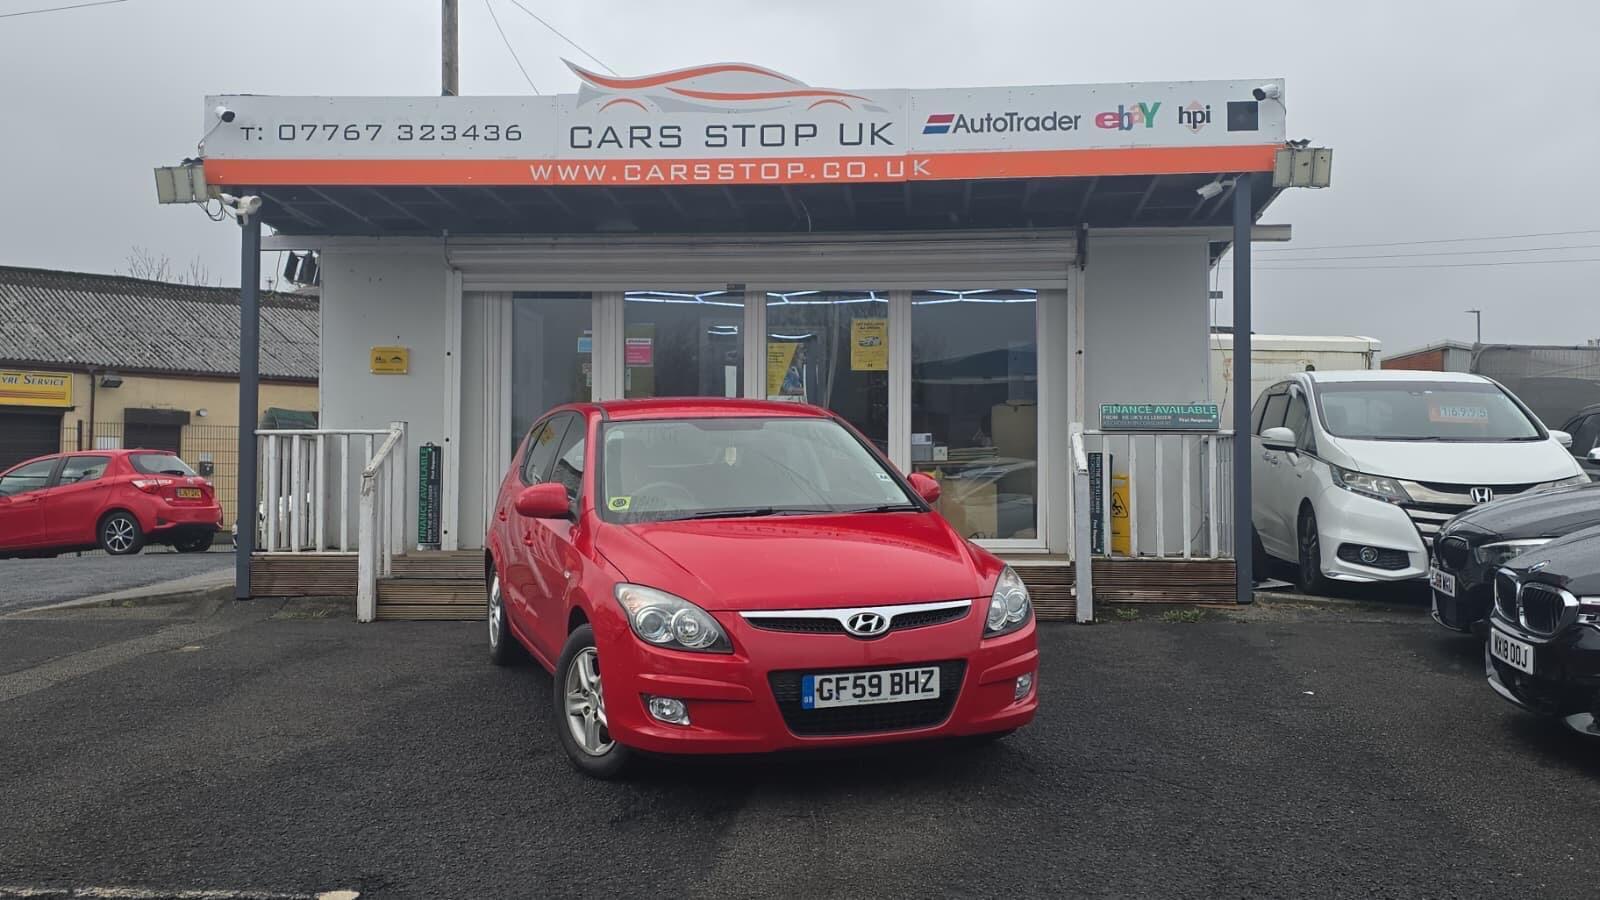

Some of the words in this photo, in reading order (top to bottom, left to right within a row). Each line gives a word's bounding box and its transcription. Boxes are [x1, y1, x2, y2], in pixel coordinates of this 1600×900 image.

[952, 111, 1081, 134] AutoTrader
[1178, 105, 1211, 130] hpi
[278, 124, 383, 142] 07767
[398, 123, 523, 142] 323436
[569, 124, 683, 150] CARS
[705, 123, 818, 149] STOP
[839, 121, 894, 147] UK
[529, 159, 931, 182] WWW.CARSSTOP.CO.UK
[1103, 405, 1152, 414] FINANCE
[1155, 405, 1217, 415] AVAILABLE
[419, 448, 428, 498] AVAILABLE
[419, 500, 427, 542] FINANCE
[818, 674, 882, 701] GF59
[889, 669, 935, 696] BHZ
